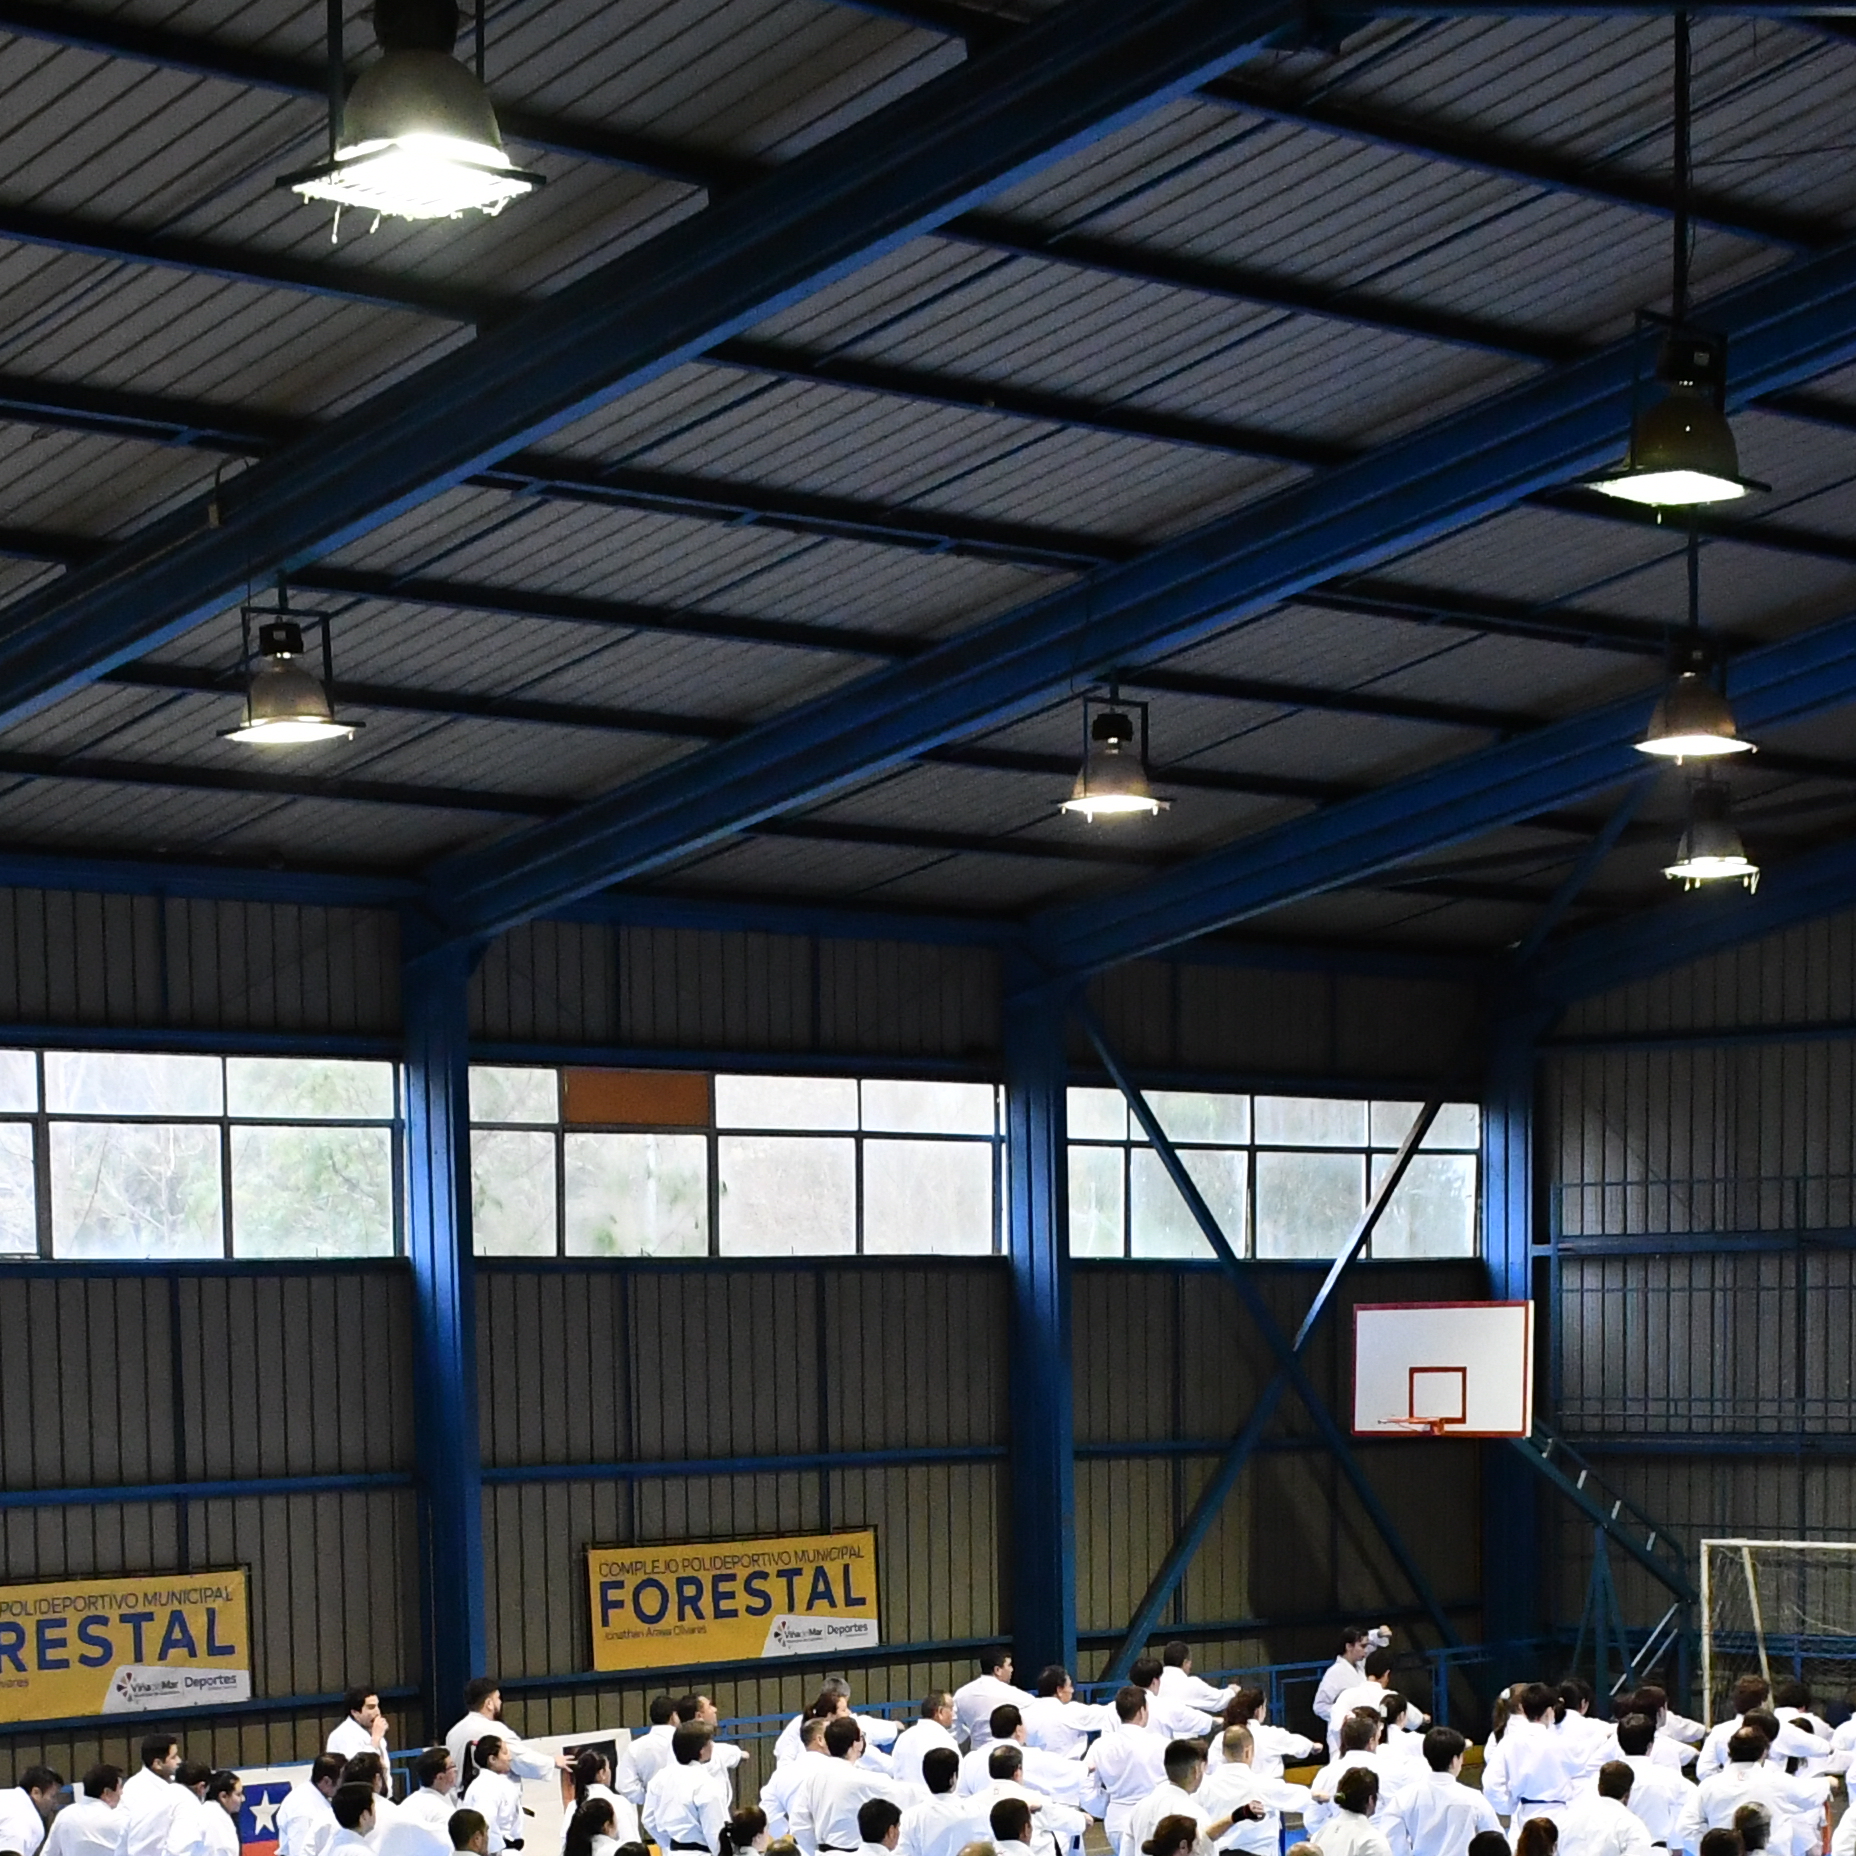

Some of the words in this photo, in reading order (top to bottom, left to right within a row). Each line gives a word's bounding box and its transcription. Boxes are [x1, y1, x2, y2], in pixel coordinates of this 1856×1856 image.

[599, 1559, 679, 1578] COMPLEJO
[683, 1550, 792, 1573] POLIDEPORTIVO
[794, 1545, 865, 1563] MUNICIPAL
[142, 1586, 234, 1607] MUNICIPAL
[599, 1563, 867, 1628] FORESTAL
[603, 1628, 644, 1641] Jonathan
[827, 1623, 869, 1637] Deportes
[184, 1673, 237, 1691] Deportes
